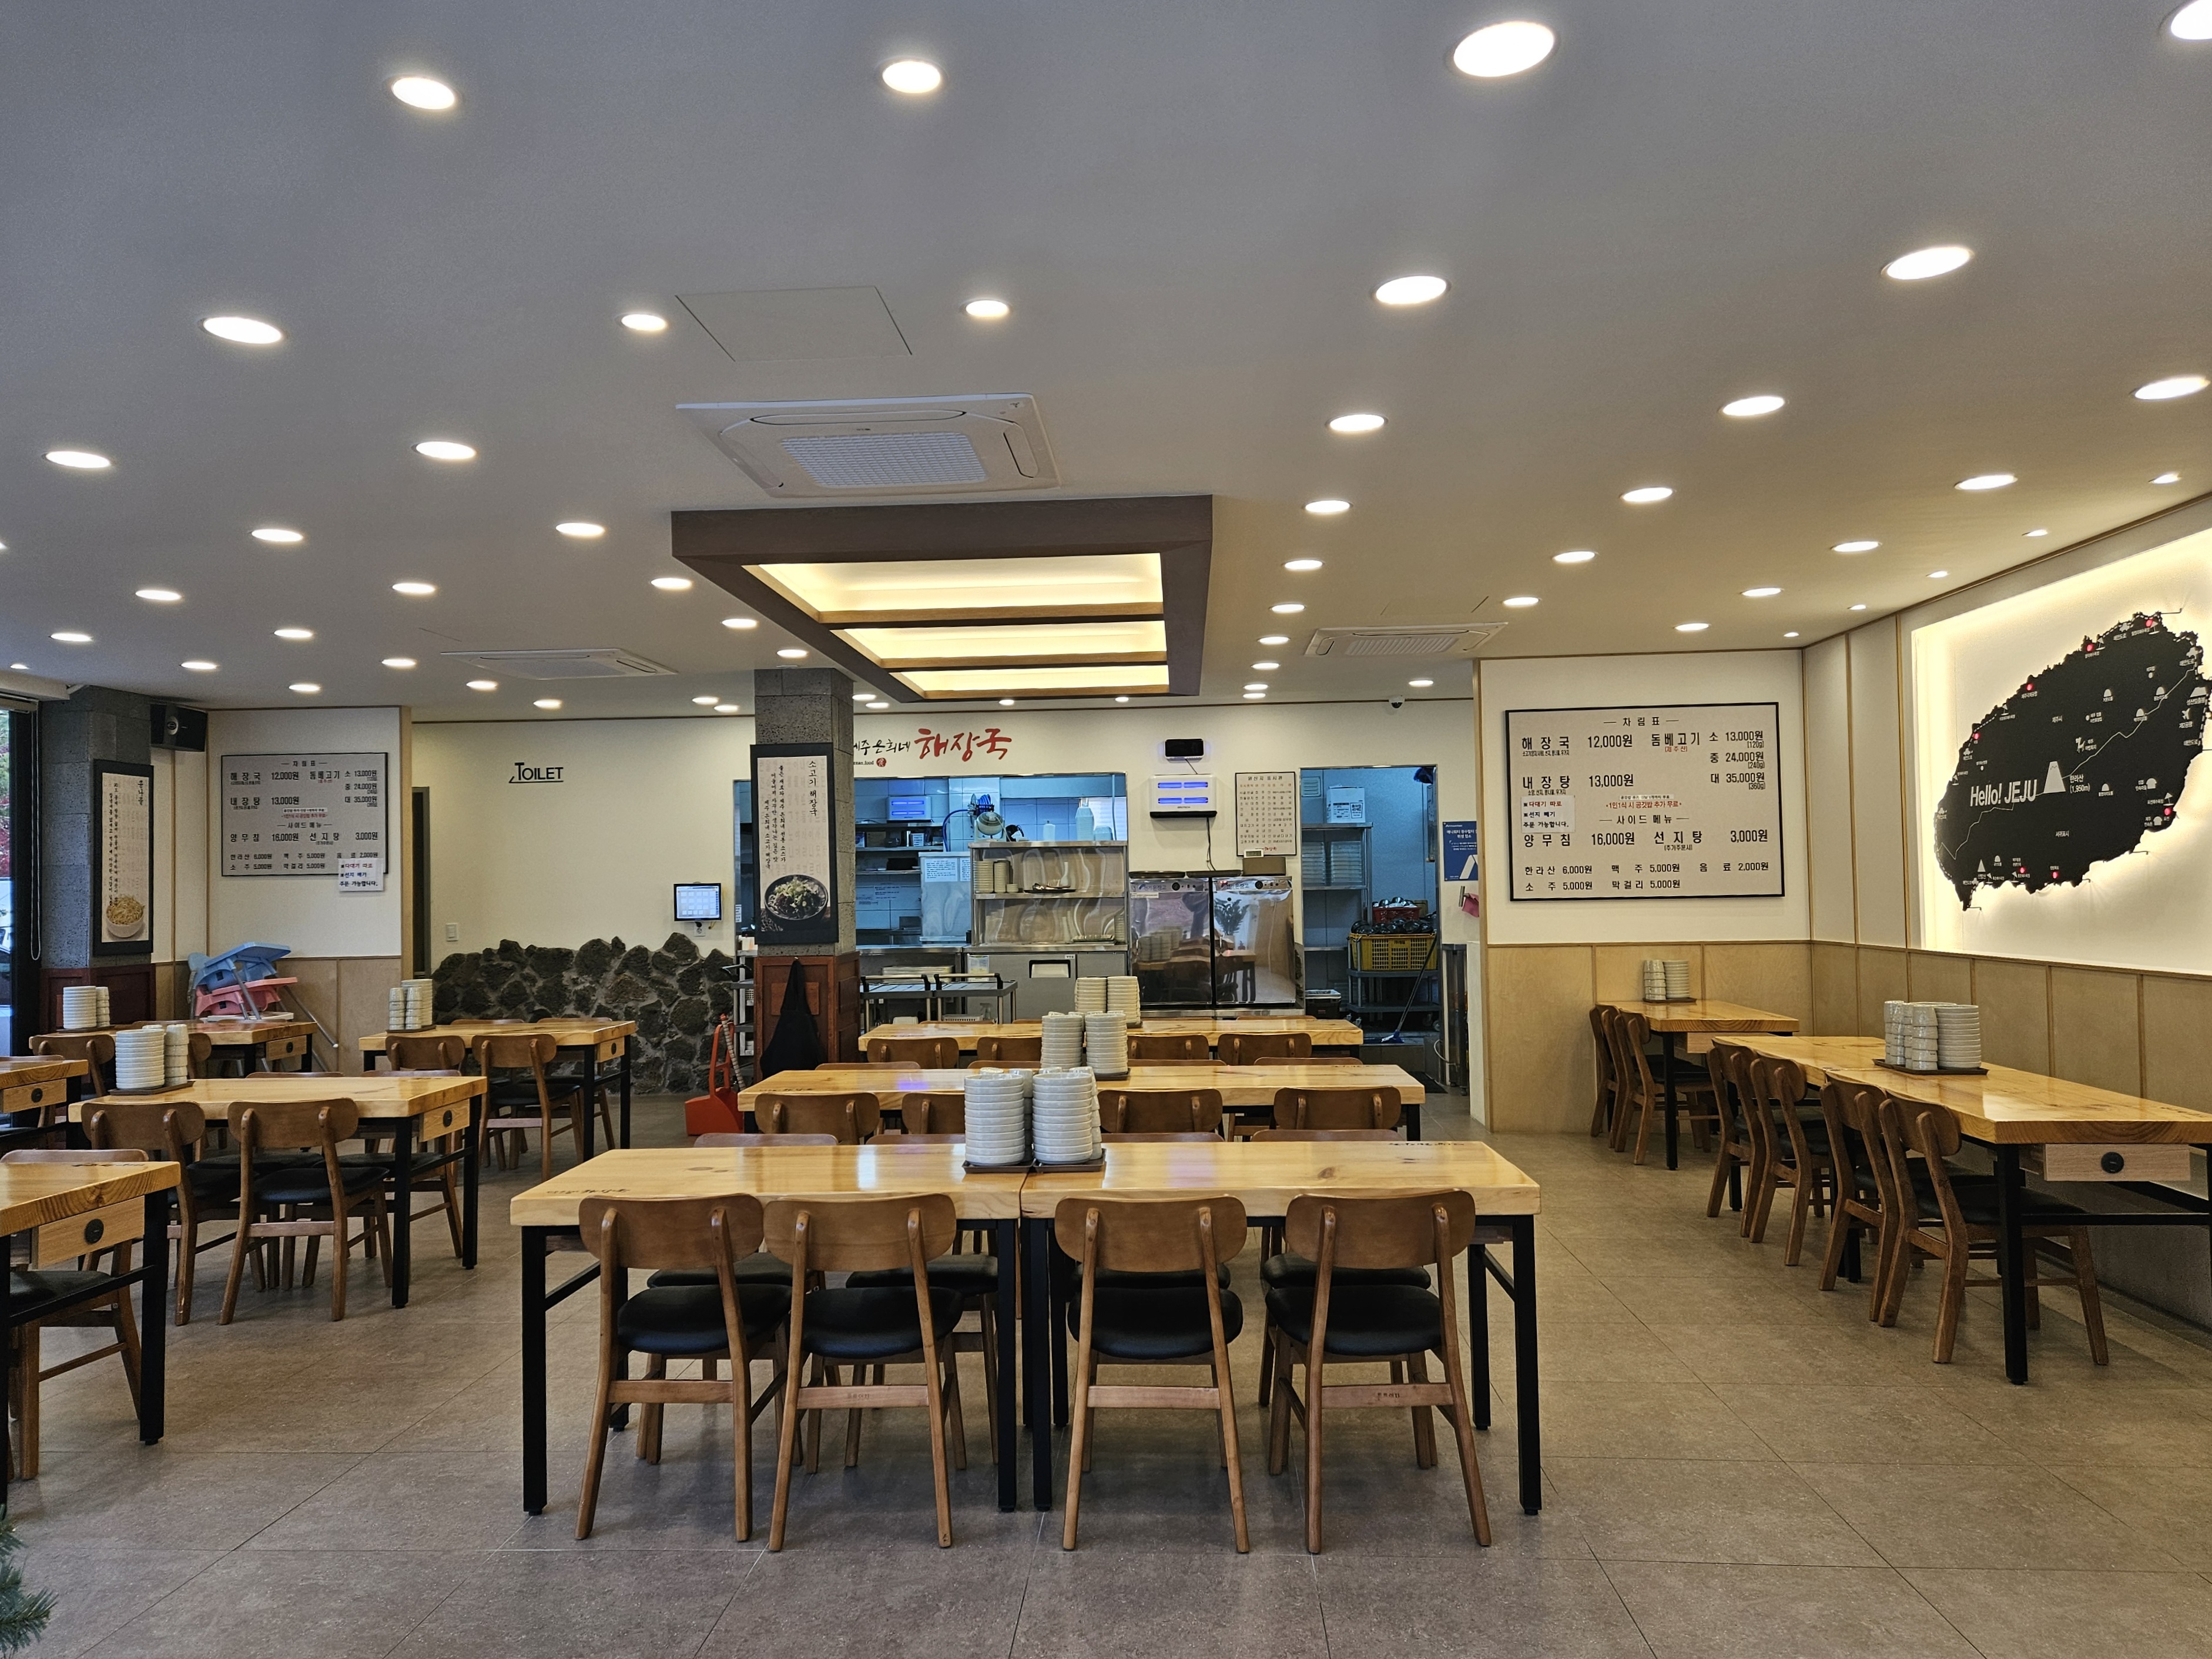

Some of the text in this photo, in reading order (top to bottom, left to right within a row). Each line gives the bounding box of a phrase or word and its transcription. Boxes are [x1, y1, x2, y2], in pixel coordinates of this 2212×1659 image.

[1623, 716, 1660, 727] 차림표
[914, 728, 1013, 762] 해장국
[1521, 730, 1764, 750] 해장국 12,000원 돔베고기 소 13,000원
[1710, 751, 1764, 763] 중 24,000원
[230, 772, 260, 781] 해장국
[271, 771, 299, 780] 12,000원
[514, 762, 564, 780] TOILET
[1522, 772, 1765, 789] 내장탕 13,000원 대 35,000원
[2069, 773, 2084, 783] 한라산
[808, 760, 817, 817] 소고기 해장국
[1970, 779, 2037, 807] Hello! JEJU
[2069, 783, 2090, 794] (1,950m)
[230, 797, 260, 806] 내장탕
[271, 796, 299, 805] 13,000원
[1617, 815, 1672, 825] 사이드 메뉴
[230, 832, 378, 843] 양무침 16,000원 선지탕 3,000원
[1524, 829, 1768, 847] 양무침 16,000원 선지탕 3,000원
[1524, 862, 1769, 876] 한라산 6,000원 맥주 5,000원 음료 2,000원
[1525, 879, 1680, 891] 소주 5,000원 막걸리 5,000원
